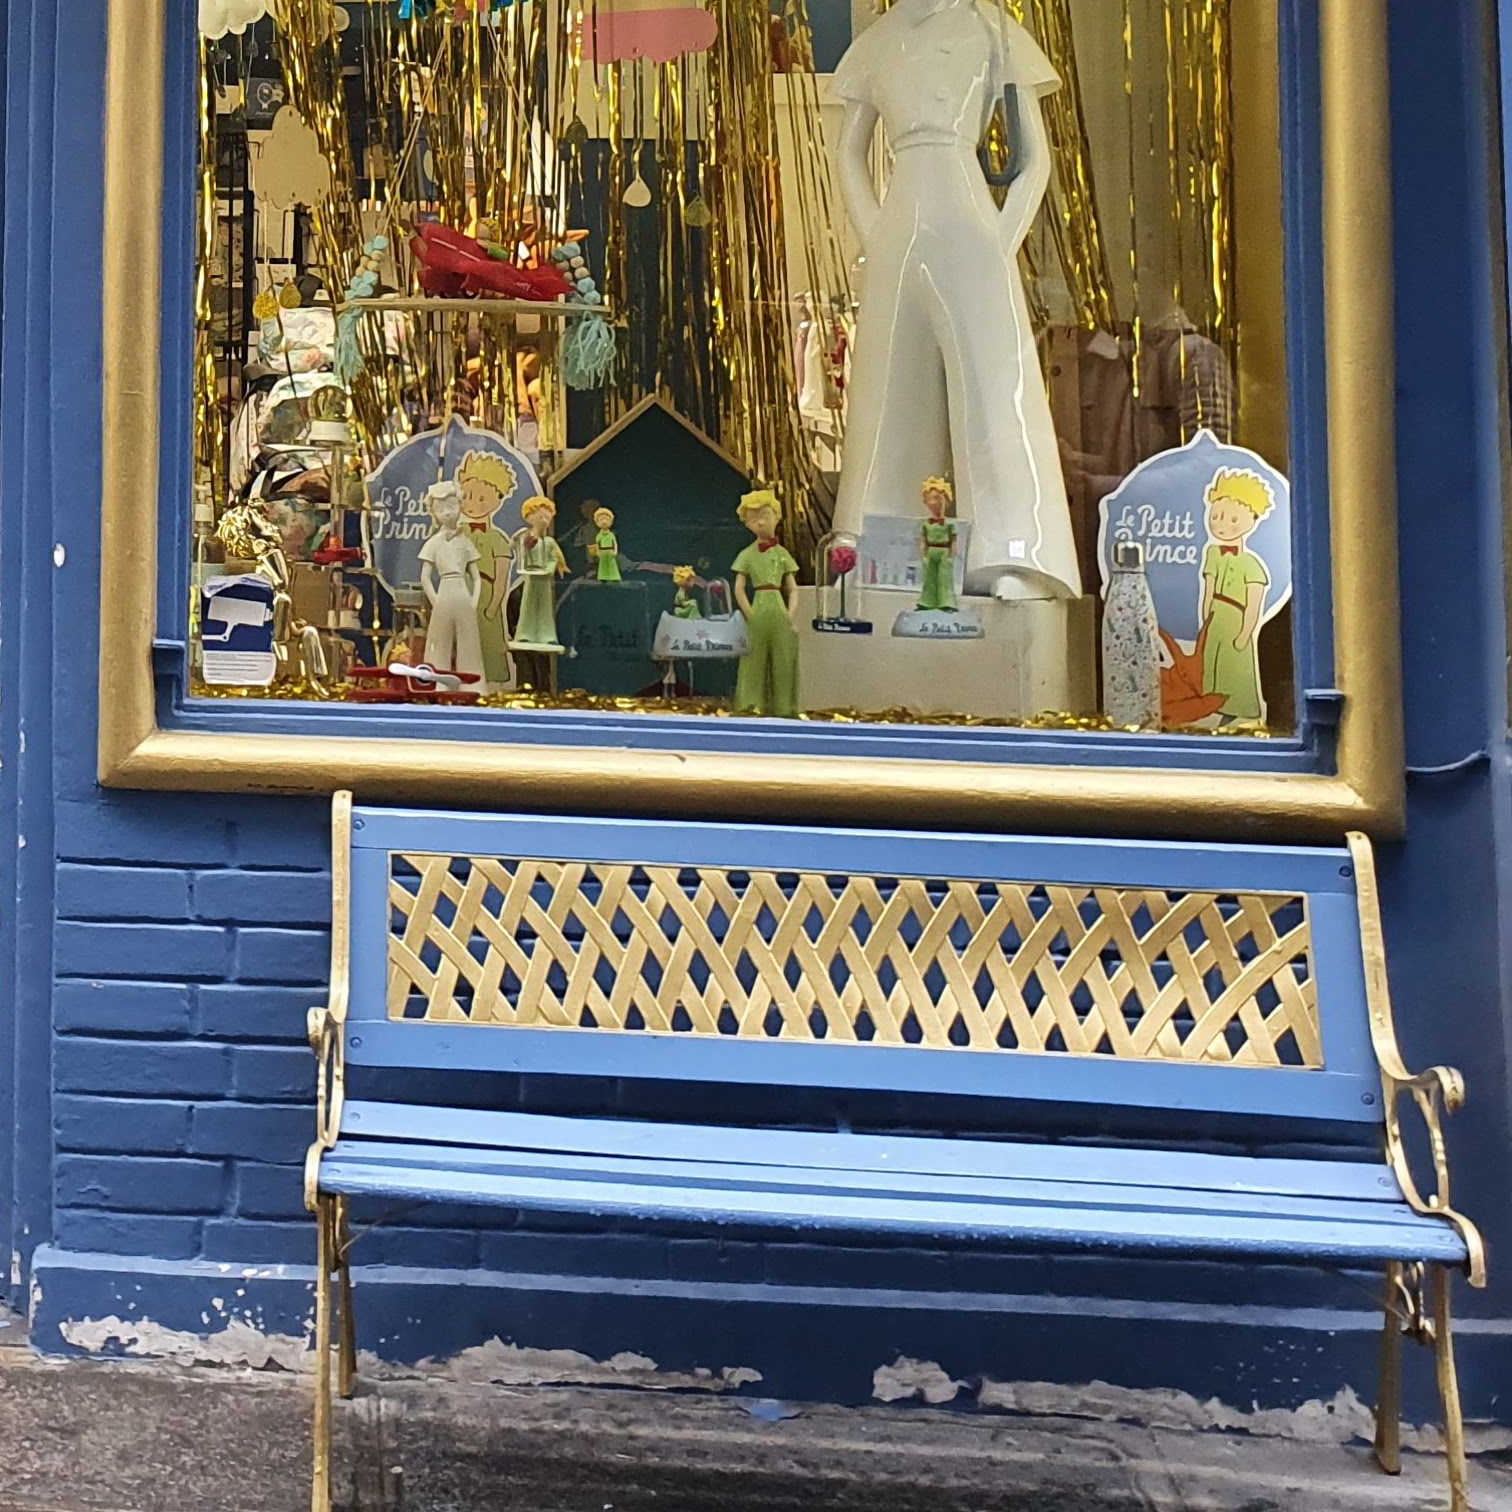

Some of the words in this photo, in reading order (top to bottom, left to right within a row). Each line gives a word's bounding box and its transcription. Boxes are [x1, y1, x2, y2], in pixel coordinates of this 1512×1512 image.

[374, 487, 393, 507] Le
[394, 485, 430, 516] Pet
[371, 508, 432, 540] Prin
[1115, 505, 1135, 527] Le
[1136, 504, 1195, 539] Petit
